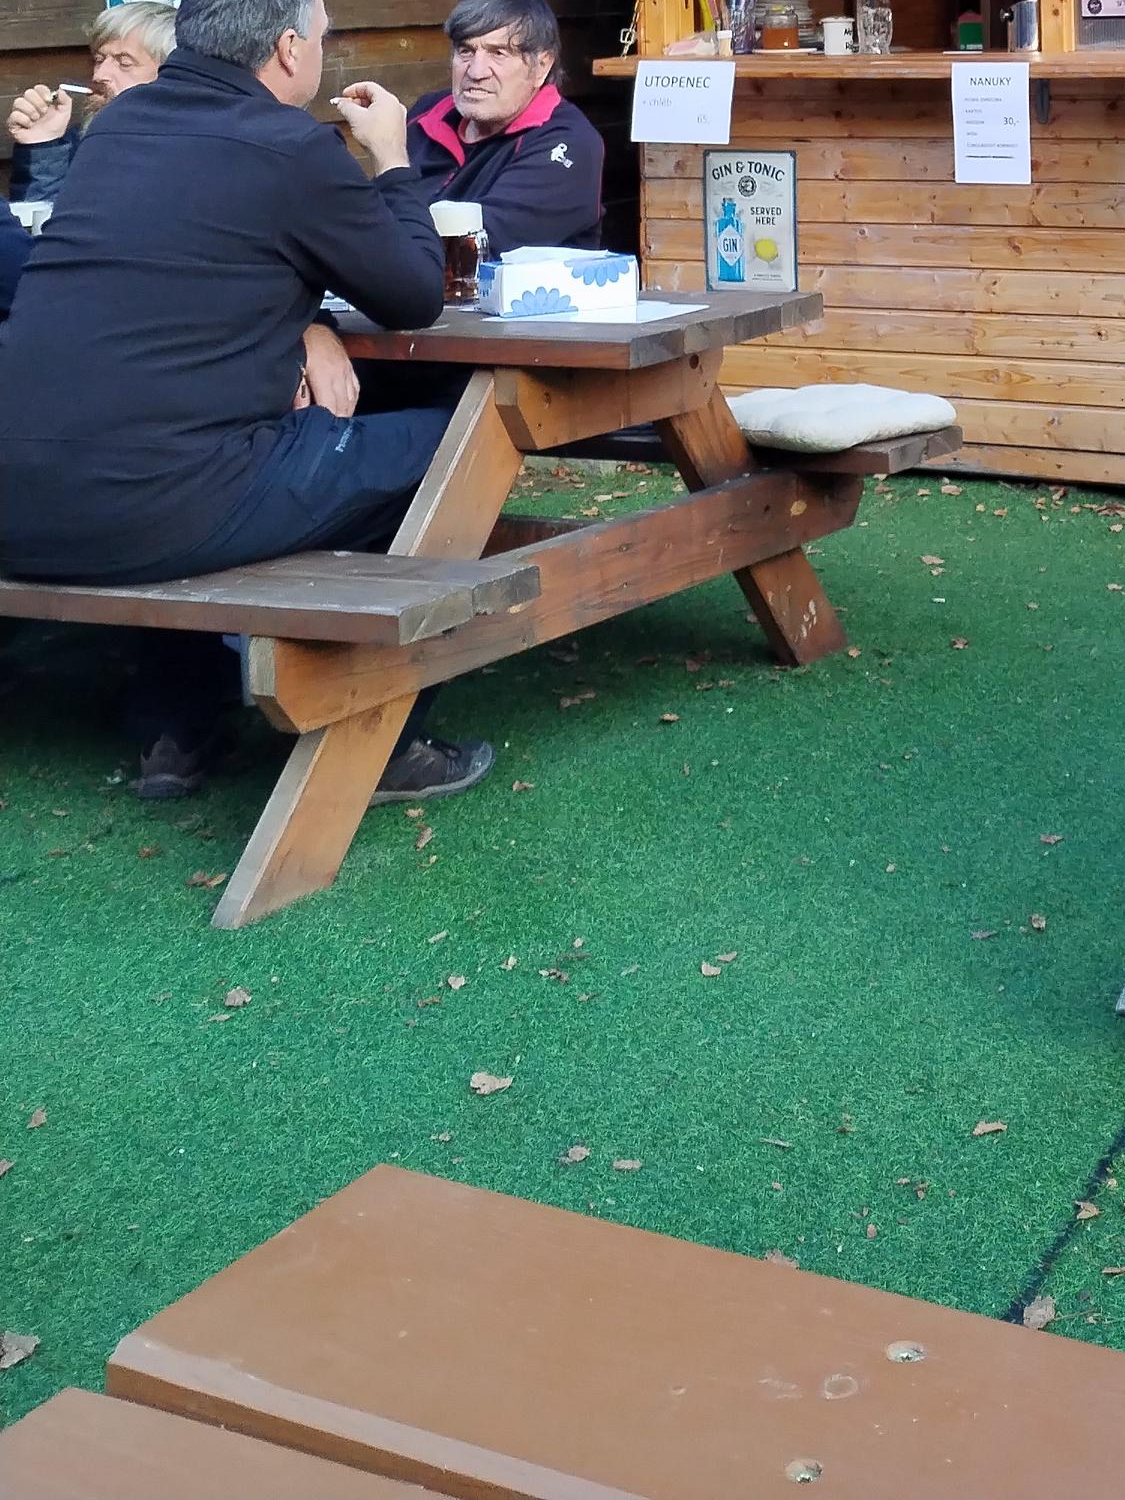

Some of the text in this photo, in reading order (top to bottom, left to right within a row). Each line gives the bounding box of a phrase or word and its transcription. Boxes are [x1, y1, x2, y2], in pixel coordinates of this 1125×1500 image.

[644, 75, 711, 88] UTOPENEC
[969, 76, 1012, 86] NANUKY
[1003, 116, 1020, 126] 30,-
[711, 161, 785, 181] GIN & TONIC
[750, 206, 782, 216] SERVED
[755, 216, 777, 226] HERE
[722, 238, 738, 253] GIN
